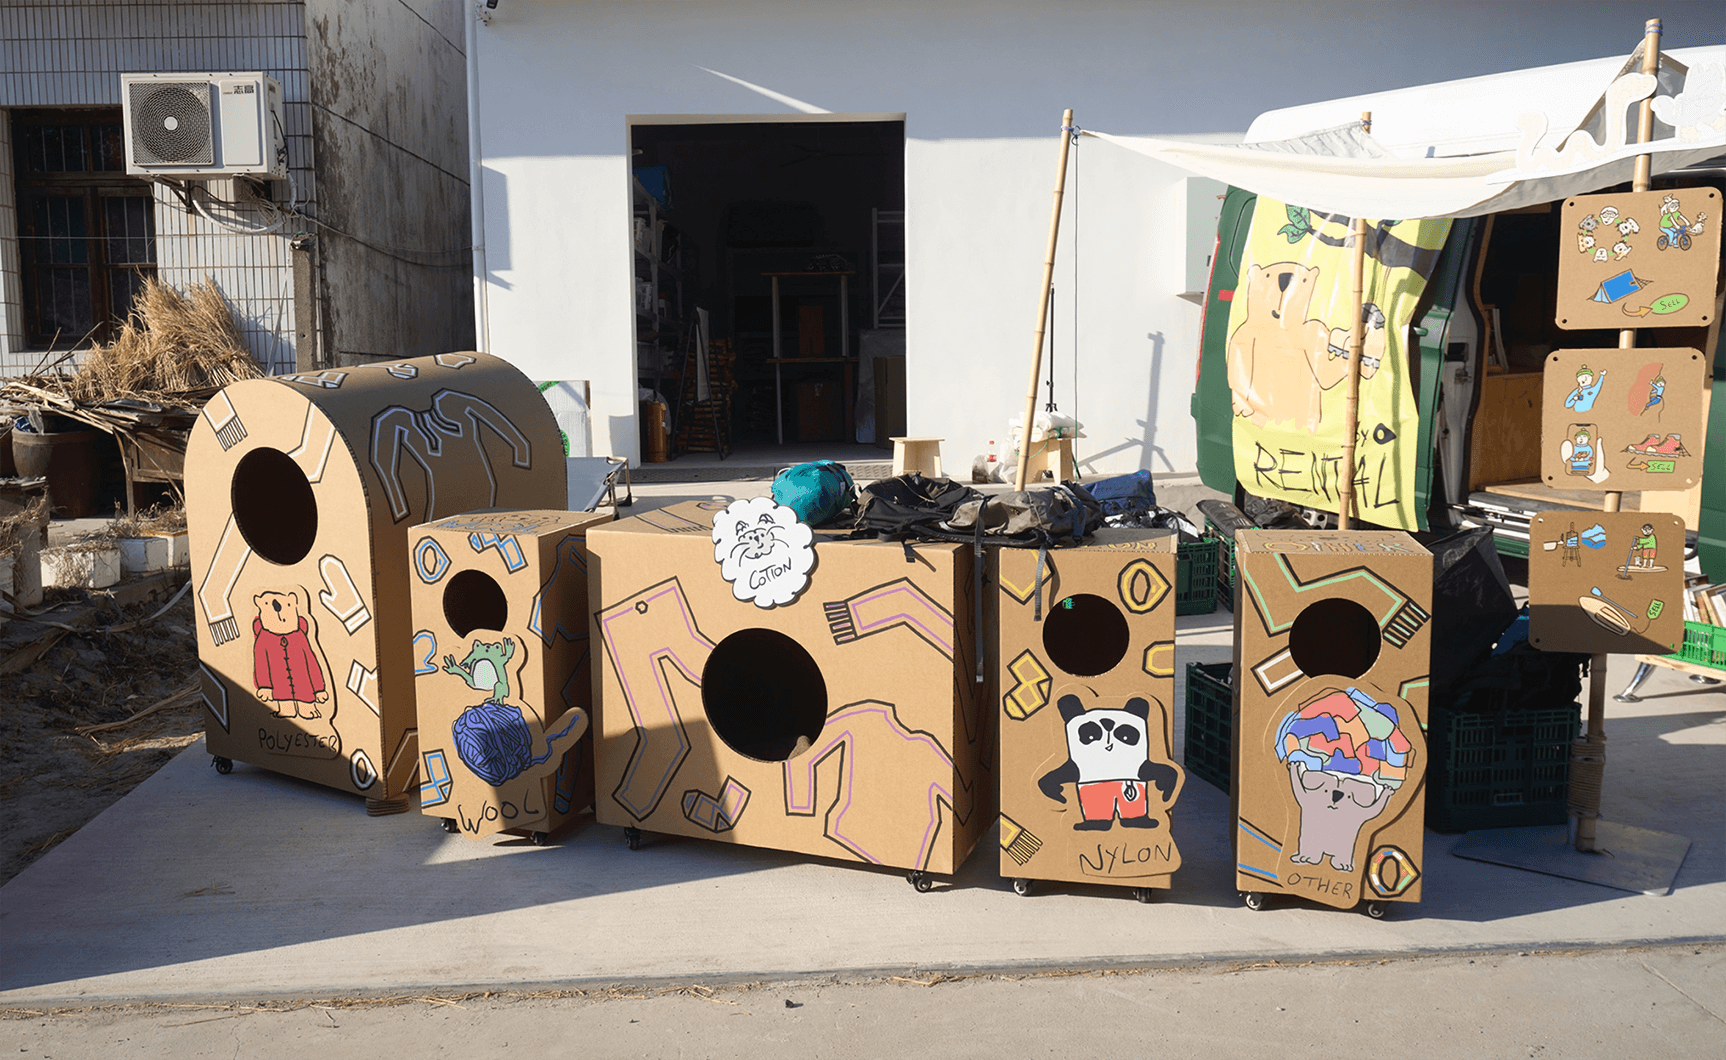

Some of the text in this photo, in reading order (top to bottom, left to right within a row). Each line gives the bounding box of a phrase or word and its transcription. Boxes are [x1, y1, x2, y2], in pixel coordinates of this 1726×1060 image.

[1659, 298, 1681, 311] SELL
[1253, 441, 1400, 510] RENTAL
[1650, 462, 1672, 471] SELL
[258, 727, 337, 753] POLYESTER
[457, 788, 540, 835] WOOL
[1079, 842, 1171, 874] NYLON
[1287, 872, 1354, 899] OTHER
